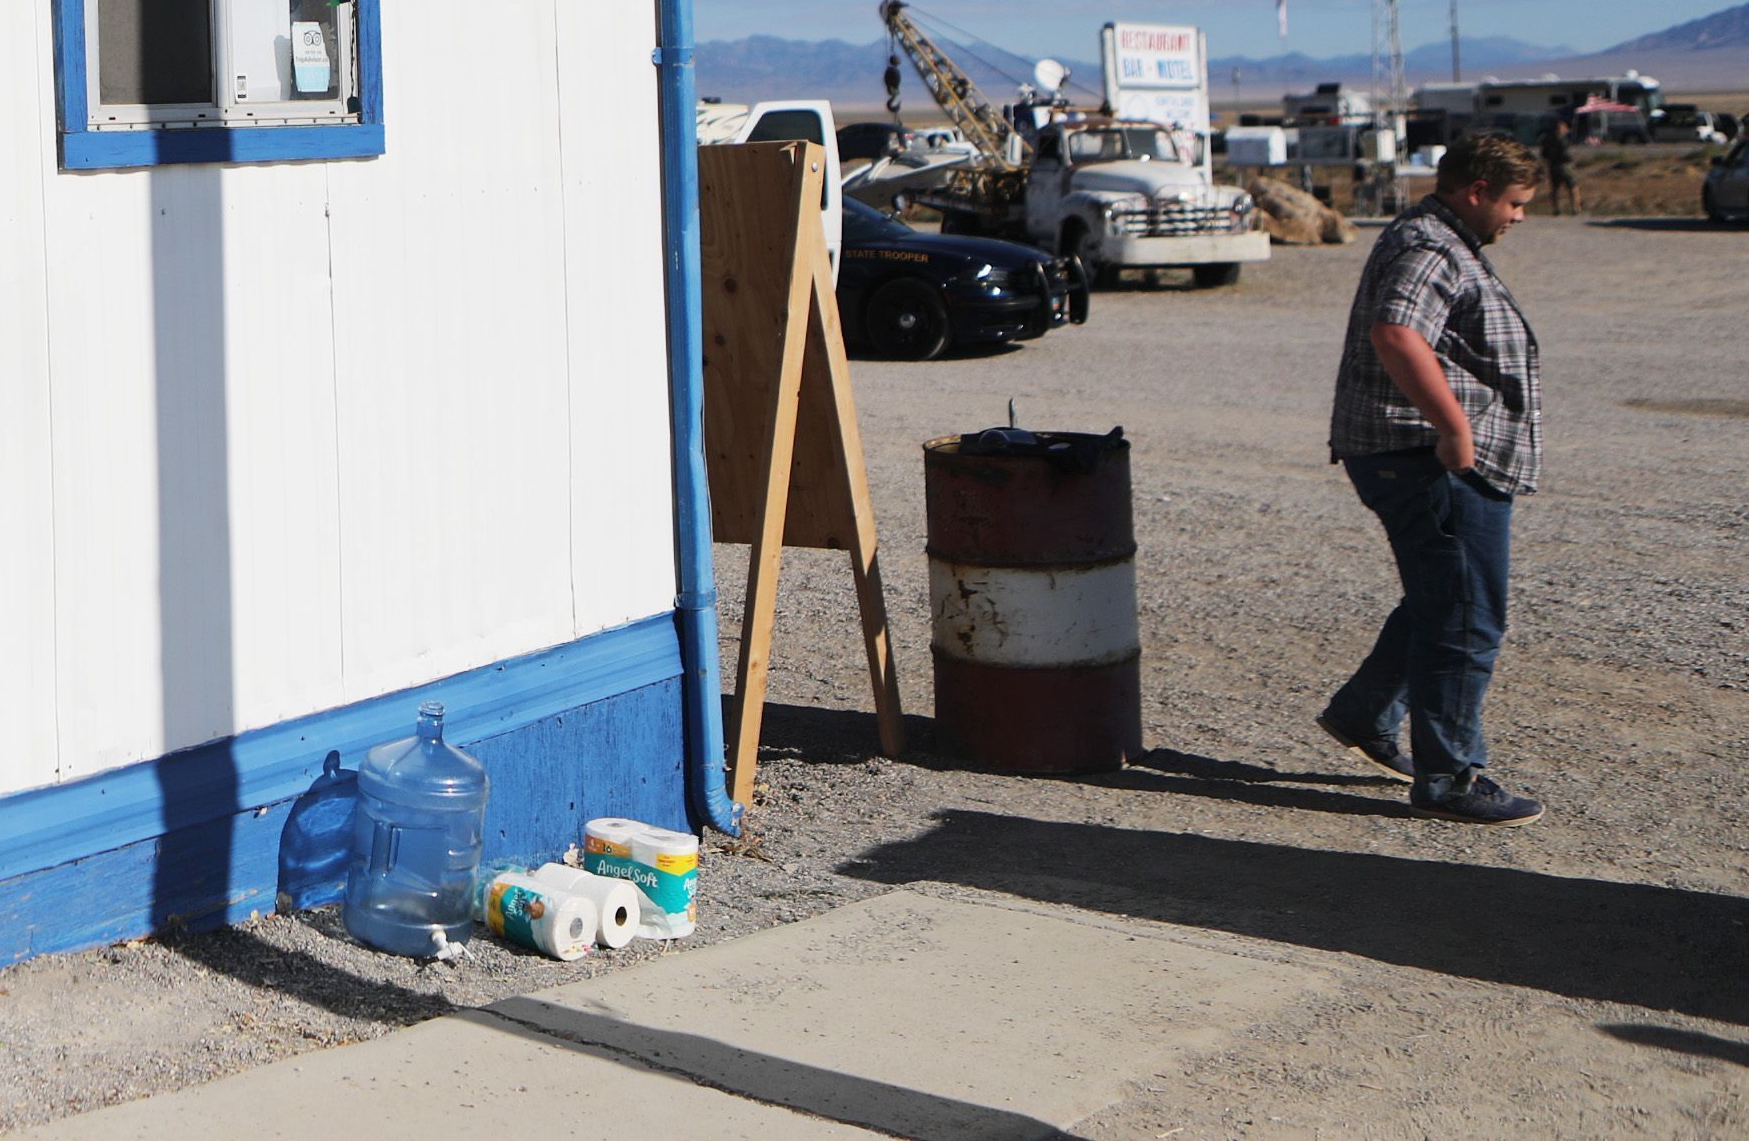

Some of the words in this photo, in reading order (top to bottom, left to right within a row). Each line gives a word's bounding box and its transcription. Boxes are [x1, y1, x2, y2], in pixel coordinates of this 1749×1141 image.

[1121, 30, 1190, 53] RESTAURANT
[1157, 58, 1194, 80] MOTEL
[845, 249, 876, 259] STATE
[880, 251, 929, 263] TROOPER
[596, 859, 633, 879] Angel
[633, 868, 659, 888] Soft
